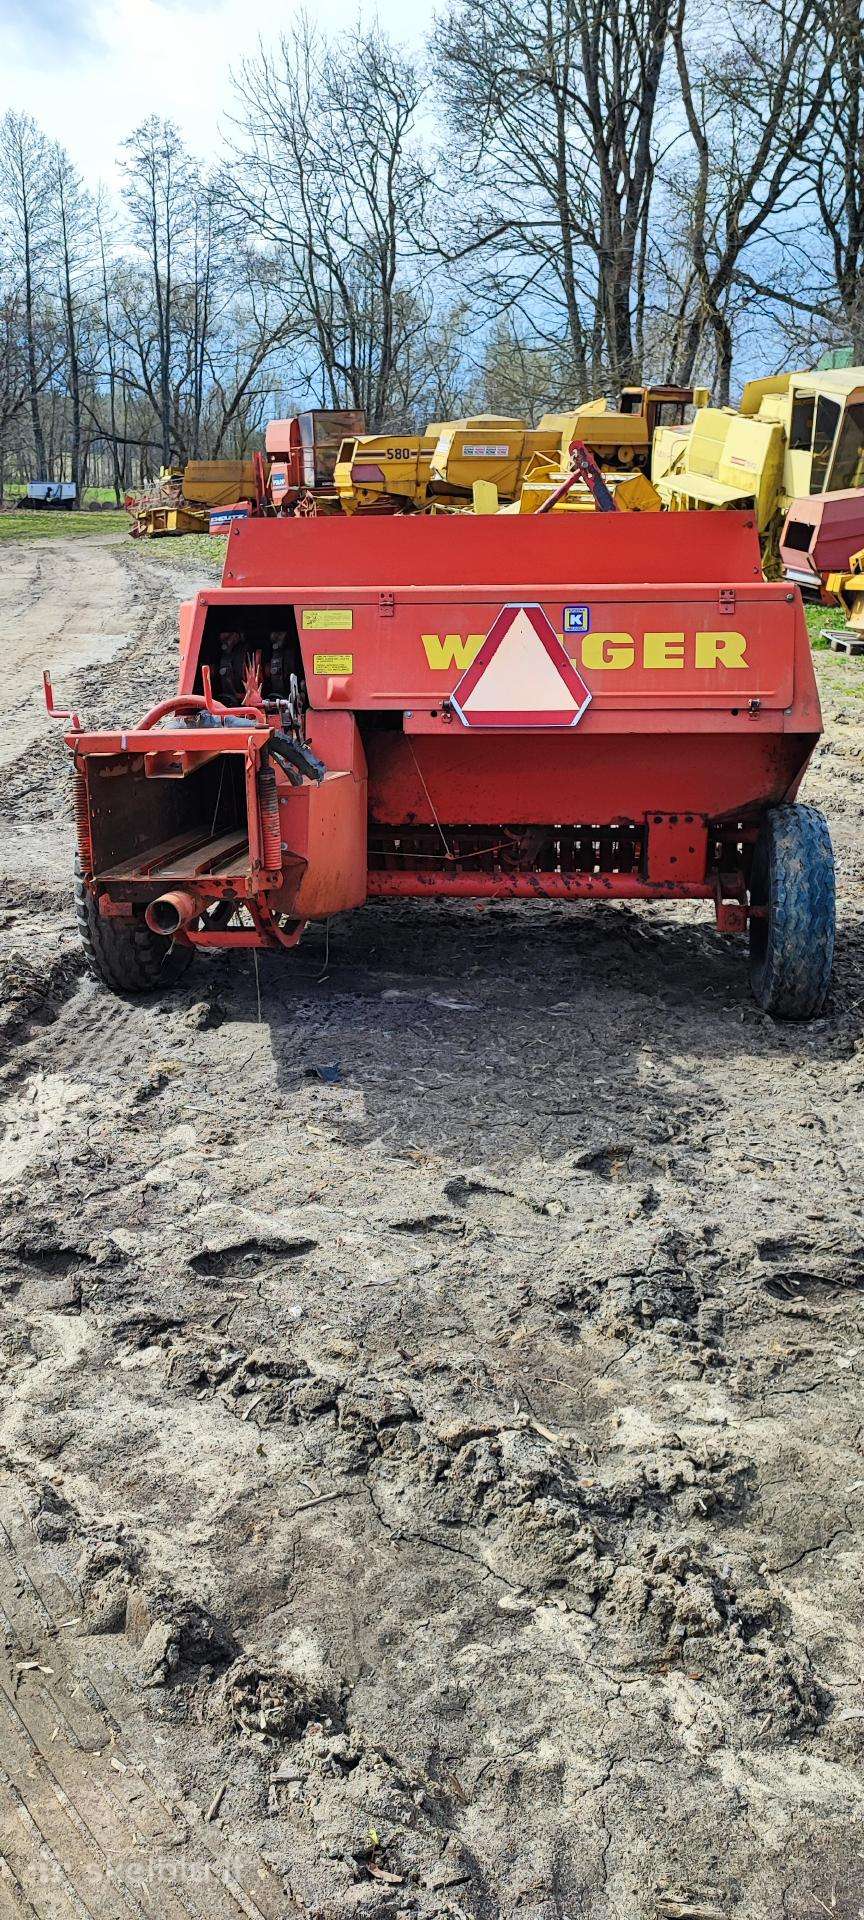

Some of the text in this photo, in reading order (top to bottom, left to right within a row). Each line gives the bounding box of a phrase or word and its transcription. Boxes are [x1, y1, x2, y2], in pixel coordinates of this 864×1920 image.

[386, 447, 411, 460] 580
[569, 613, 583, 626] K
[421, 632, 749, 670] WGER
